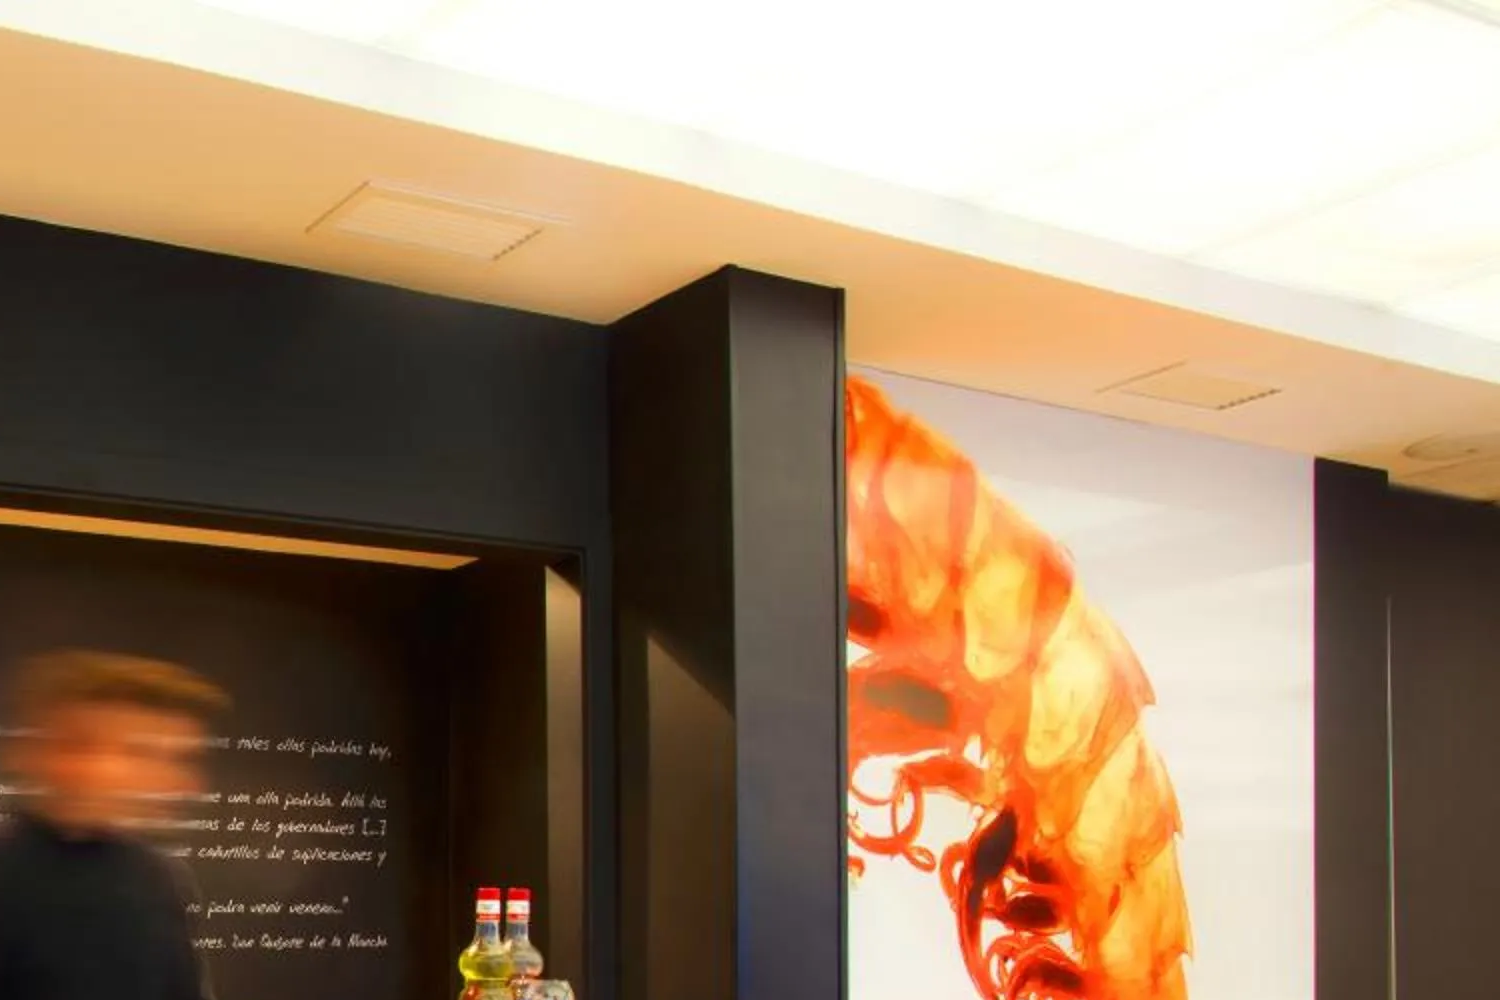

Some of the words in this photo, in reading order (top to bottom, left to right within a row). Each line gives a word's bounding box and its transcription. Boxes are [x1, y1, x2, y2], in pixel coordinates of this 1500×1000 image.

[227, 793, 251, 804] una
[227, 817, 245, 831] de
[267, 845, 285, 860] de
[376, 851, 388, 867] y
